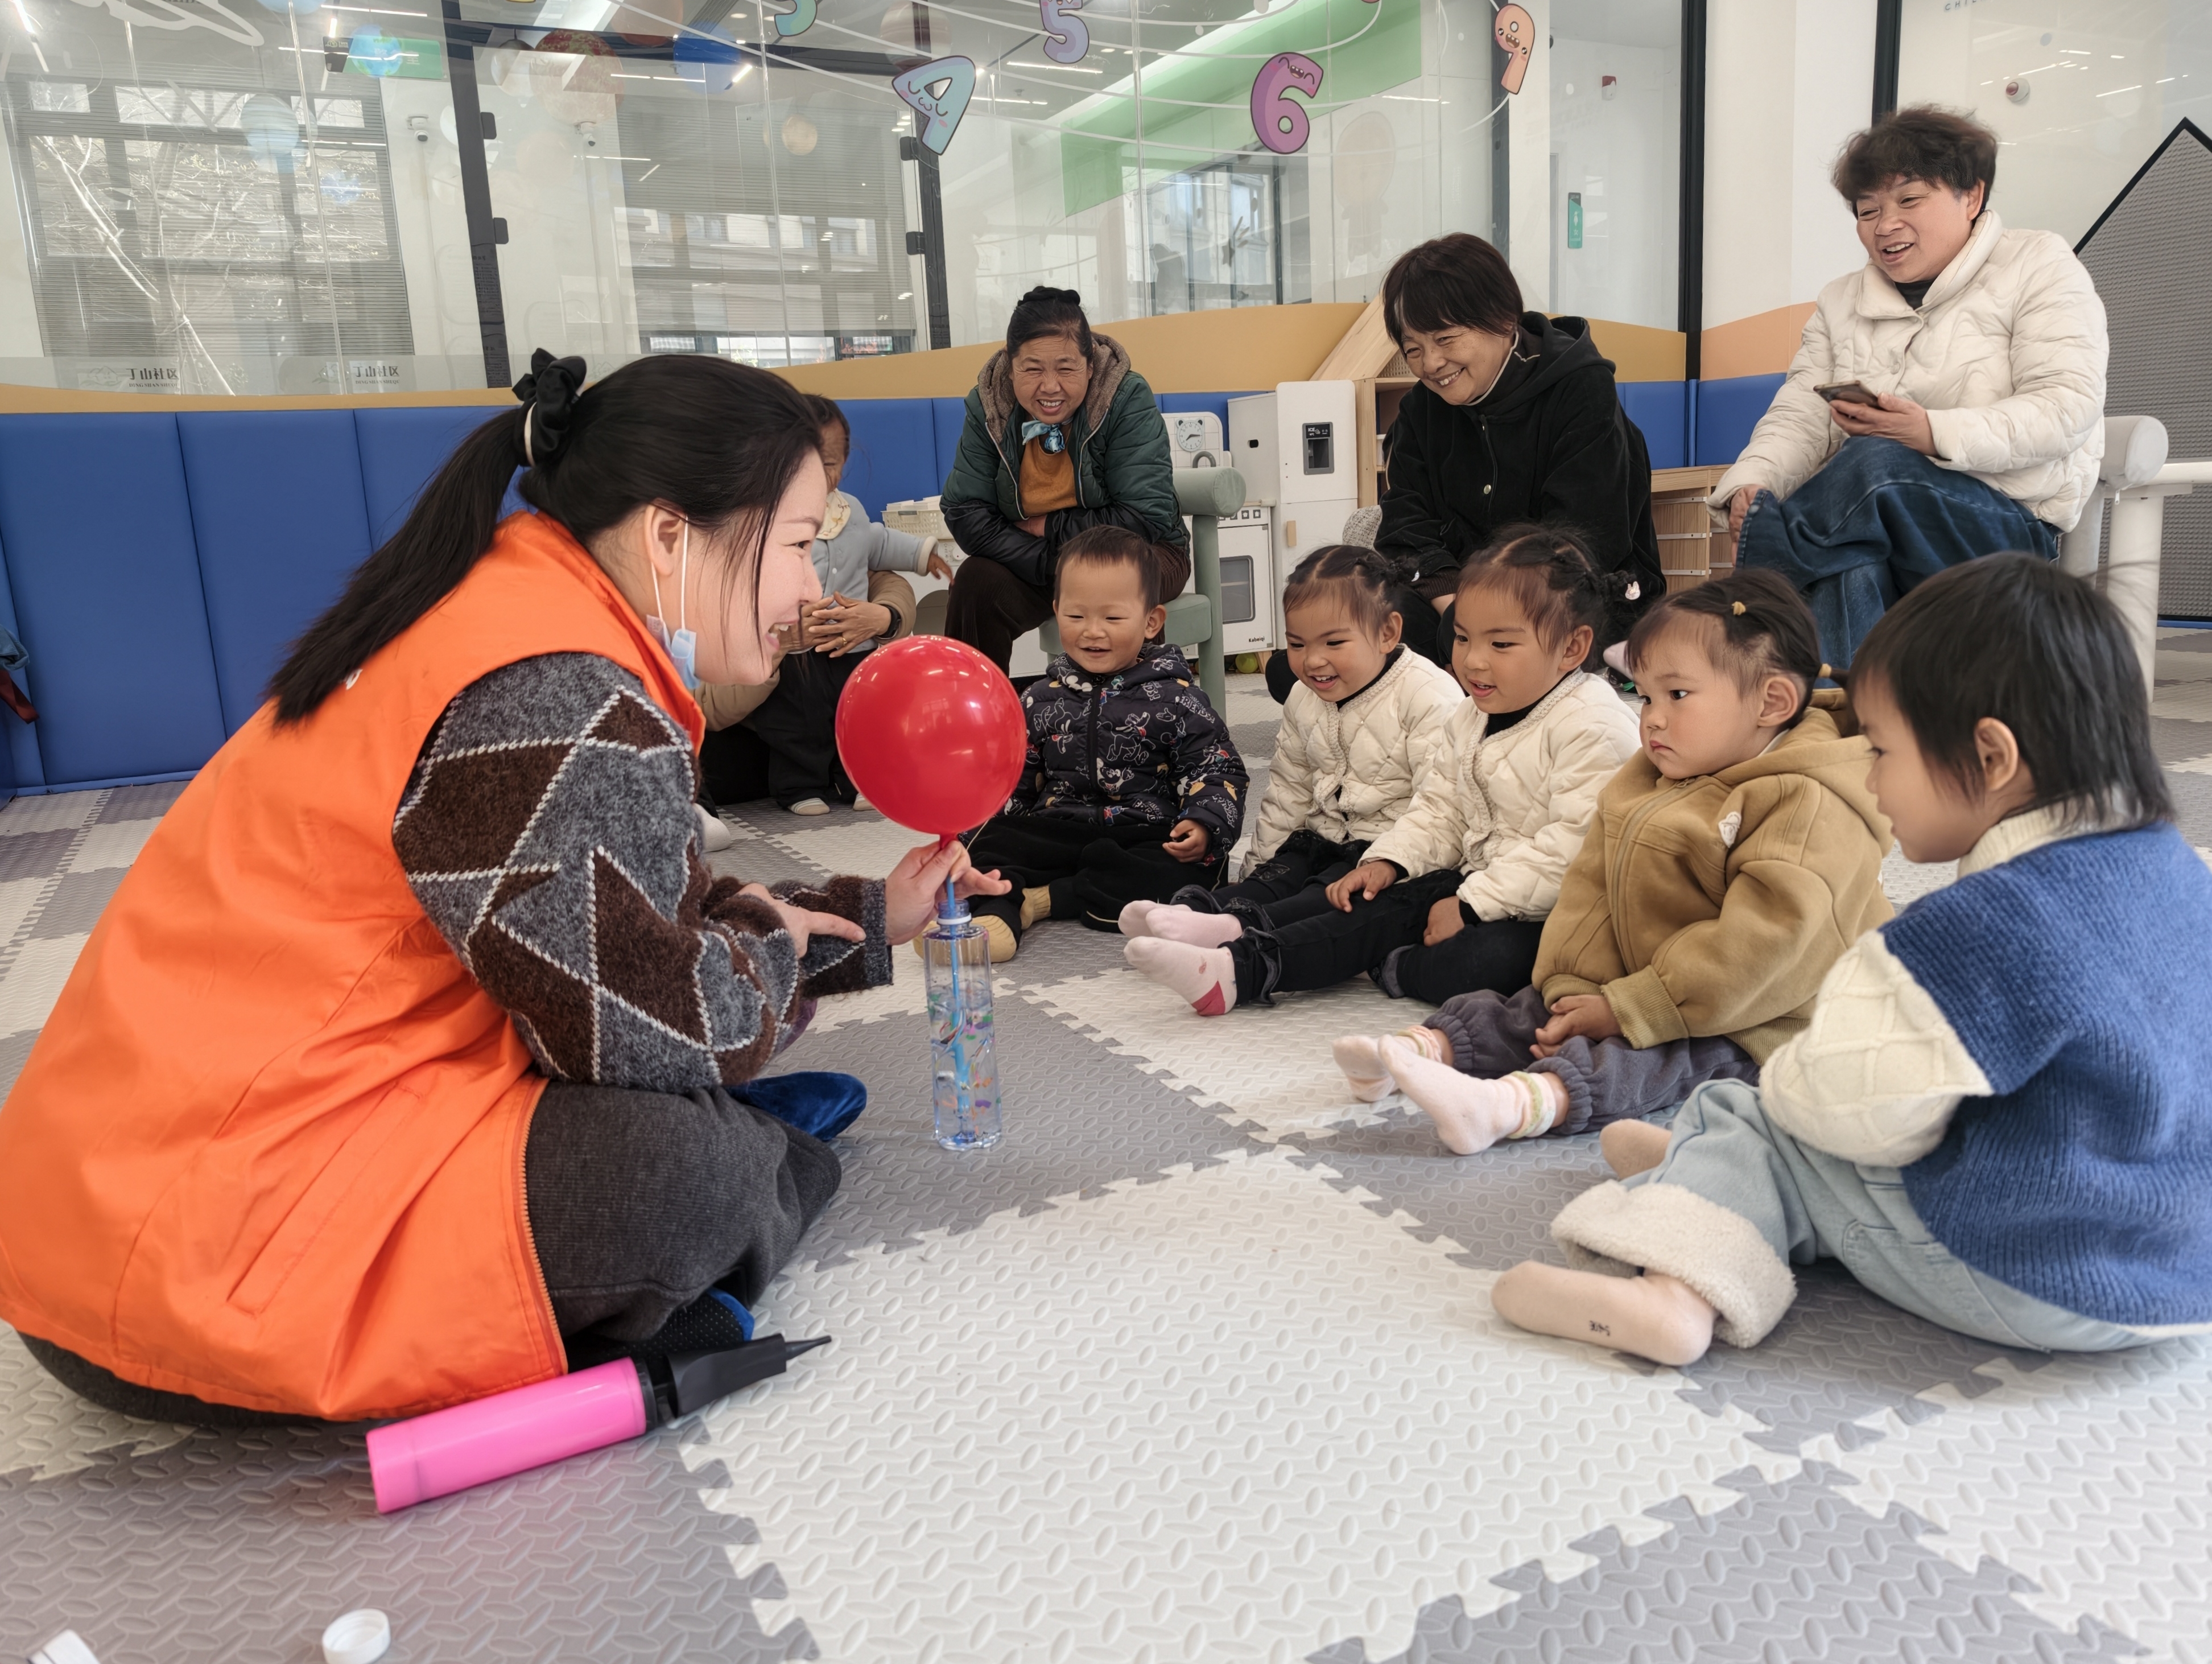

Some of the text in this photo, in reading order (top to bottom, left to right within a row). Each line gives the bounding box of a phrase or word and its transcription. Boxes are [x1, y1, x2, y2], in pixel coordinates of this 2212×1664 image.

[1039, 0, 1090, 64] 5
[1495, 3, 1535, 95] 9
[891, 55, 977, 156] 4
[1250, 52, 1324, 155] 6
[126, 368, 179, 380] 丁山社区
[353, 365, 400, 377] 丁山社区
